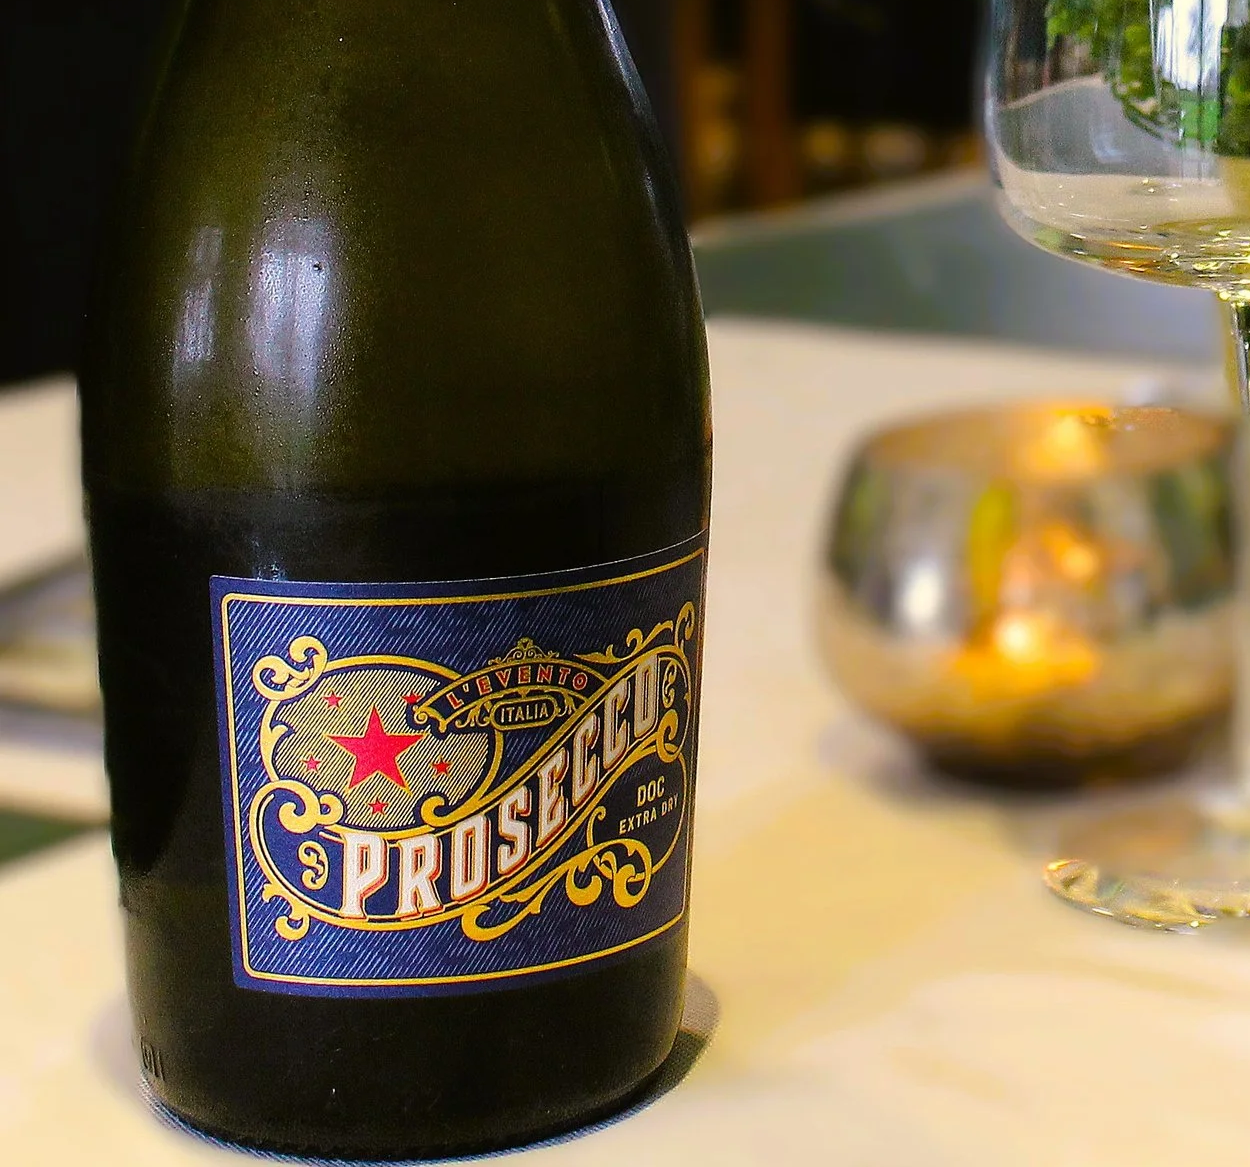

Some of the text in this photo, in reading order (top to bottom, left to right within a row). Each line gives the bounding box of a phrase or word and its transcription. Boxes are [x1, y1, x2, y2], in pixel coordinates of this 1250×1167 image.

[445, 663, 588, 710] L'EVENTO
[500, 703, 549, 723] ITALIA
[340, 653, 663, 920] PROSECCO
[636, 775, 665, 808] DOC
[619, 793, 679, 835] EXTRA DRY
